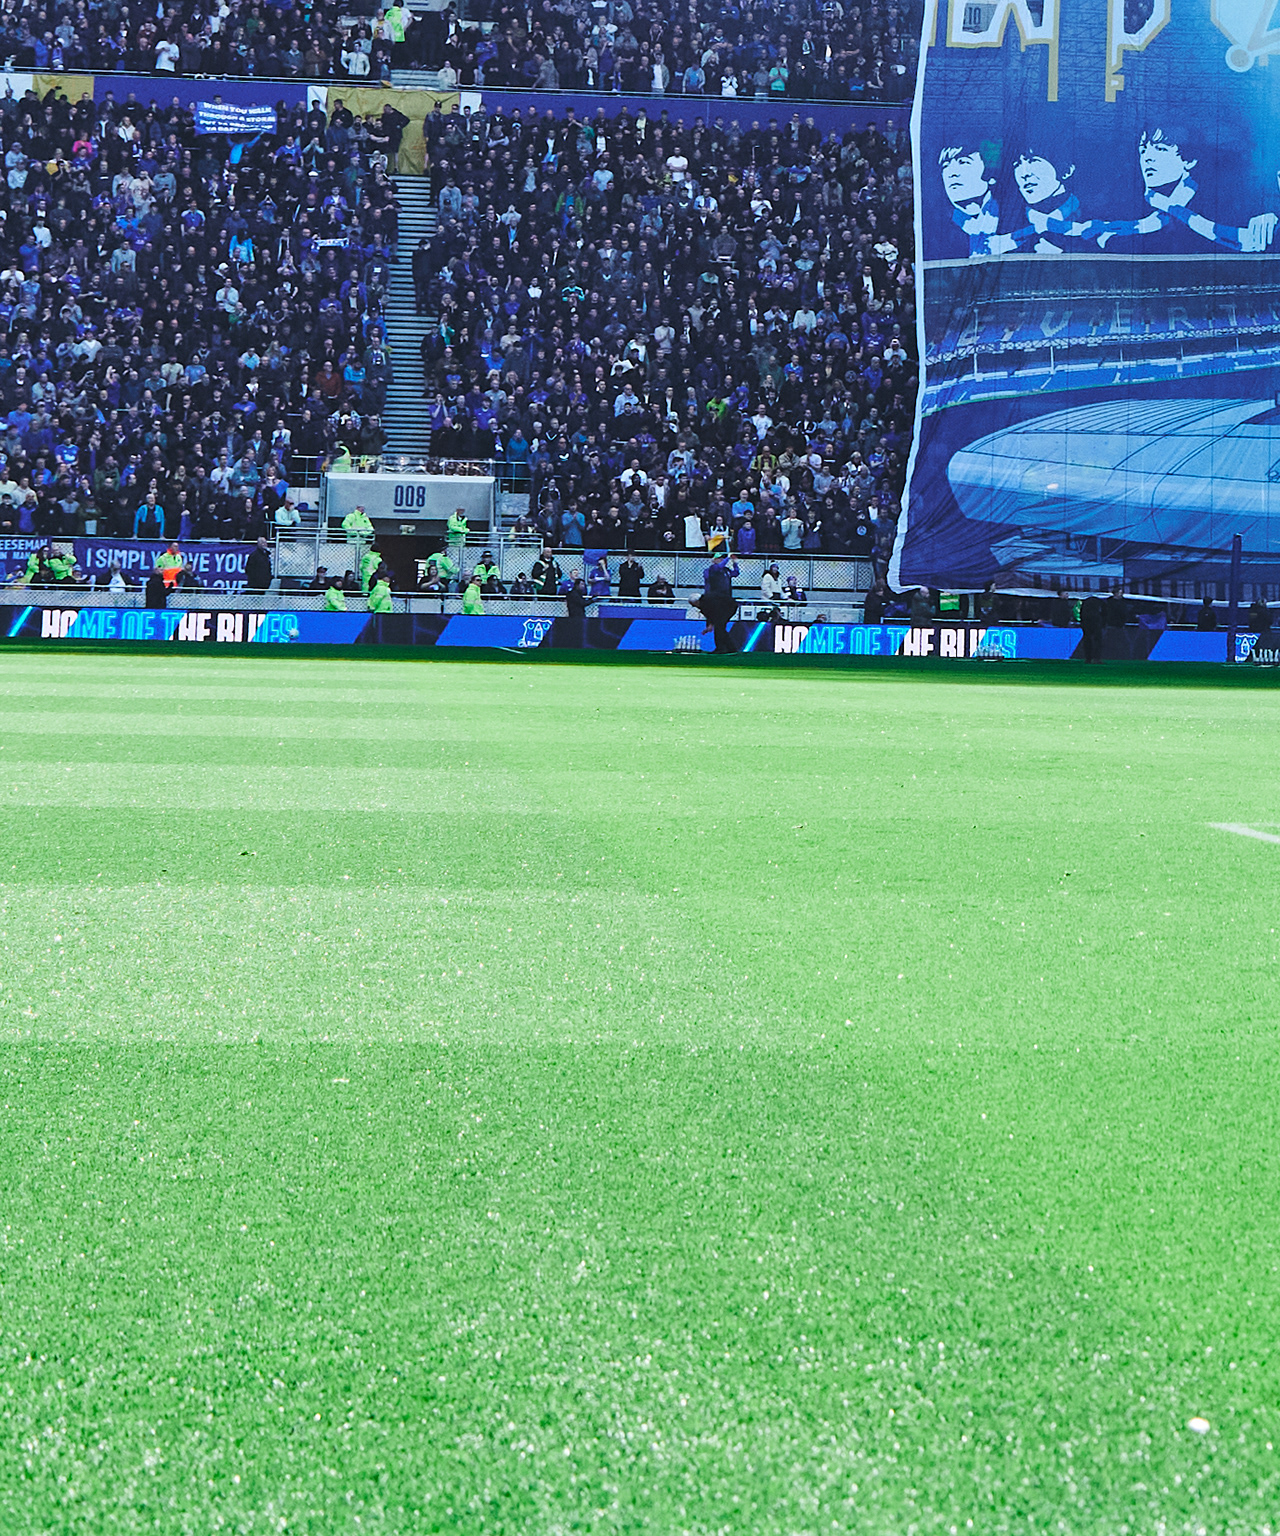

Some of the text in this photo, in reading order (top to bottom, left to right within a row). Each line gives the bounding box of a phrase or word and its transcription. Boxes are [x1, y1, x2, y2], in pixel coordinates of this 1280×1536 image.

[964, 7, 981, 25] 10
[230, 106, 247, 114] YOU
[394, 485, 426, 507] 008
[86, 548, 92, 567] I
[95, 549, 161, 570] SIMPLY
[215, 553, 250, 573] YOU
